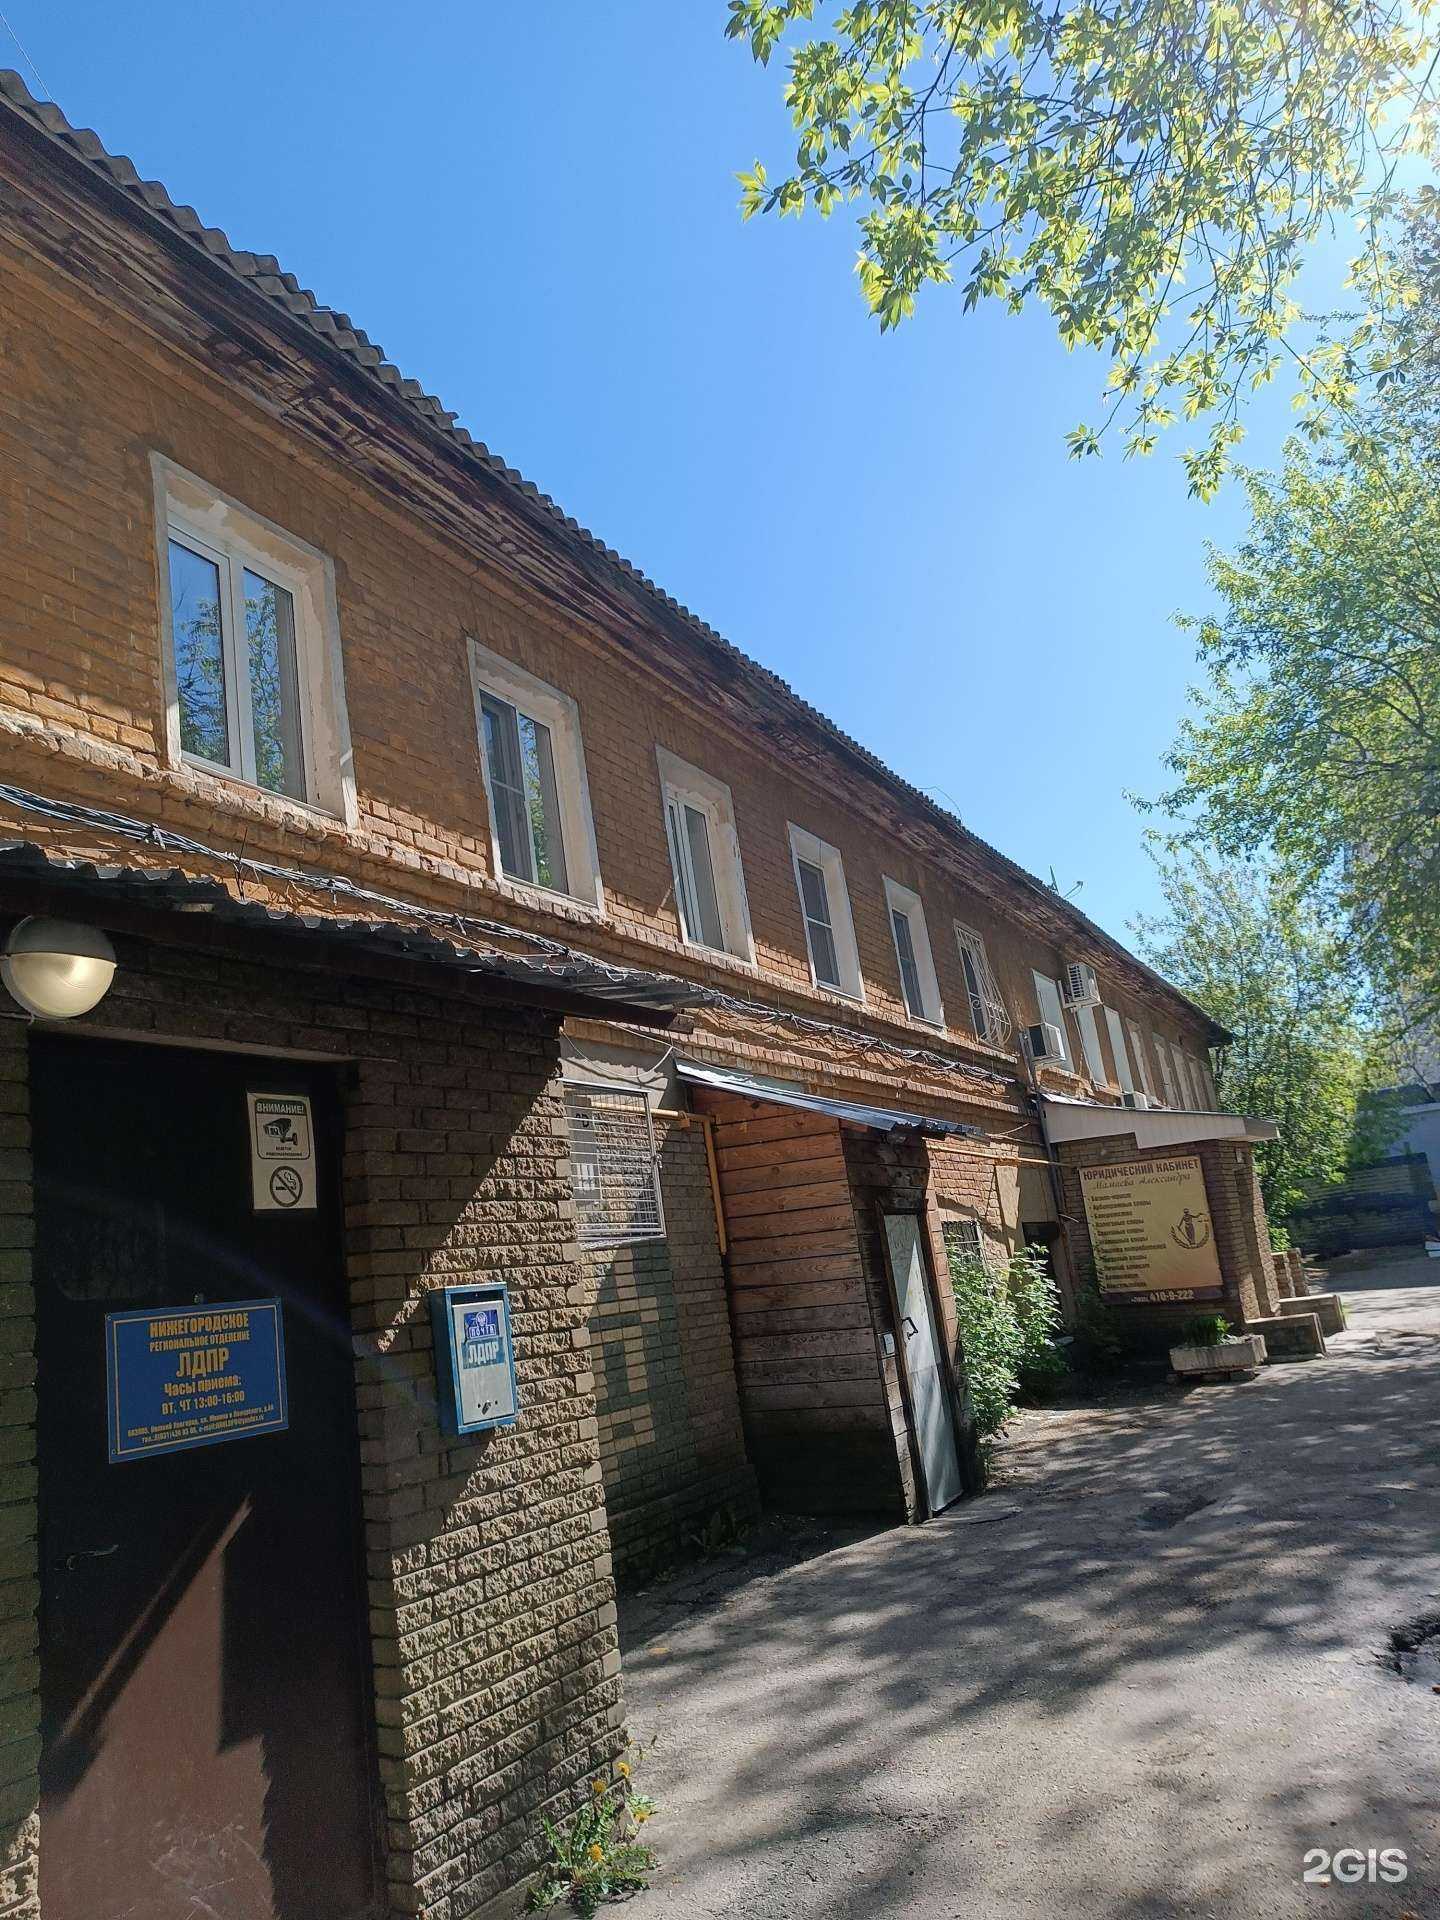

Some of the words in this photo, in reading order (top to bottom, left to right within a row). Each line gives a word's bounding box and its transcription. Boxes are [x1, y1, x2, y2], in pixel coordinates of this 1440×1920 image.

[256, 1103, 304, 1114] ВНИМАНИЕ!
[1083, 1163, 1154, 1180] ЮРИДИЧЕСКИЙ
[1156, 1159, 1200, 1173] КАБИНЕТ
[149, 1313, 249, 1338] НИЖЕГОРОДСКОЕ
[469, 1326, 496, 1338] ПОЧТА
[149, 1335, 209, 1352] РЕГИОНАЛЬНОЕ
[210, 1330, 250, 1345] ОТДЕЛЕНИЕ
[176, 1347, 230, 1378] ЛДПР
[468, 1343, 499, 1365] ЛДПР
[164, 1381, 196, 1397] Часы
[198, 1375, 242, 1393] приема:
[161, 1402, 177, 1415] ВТ,
[179, 1398, 192, 1411] ЧТ
[194, 1390, 246, 1409] 13:00-16:00
